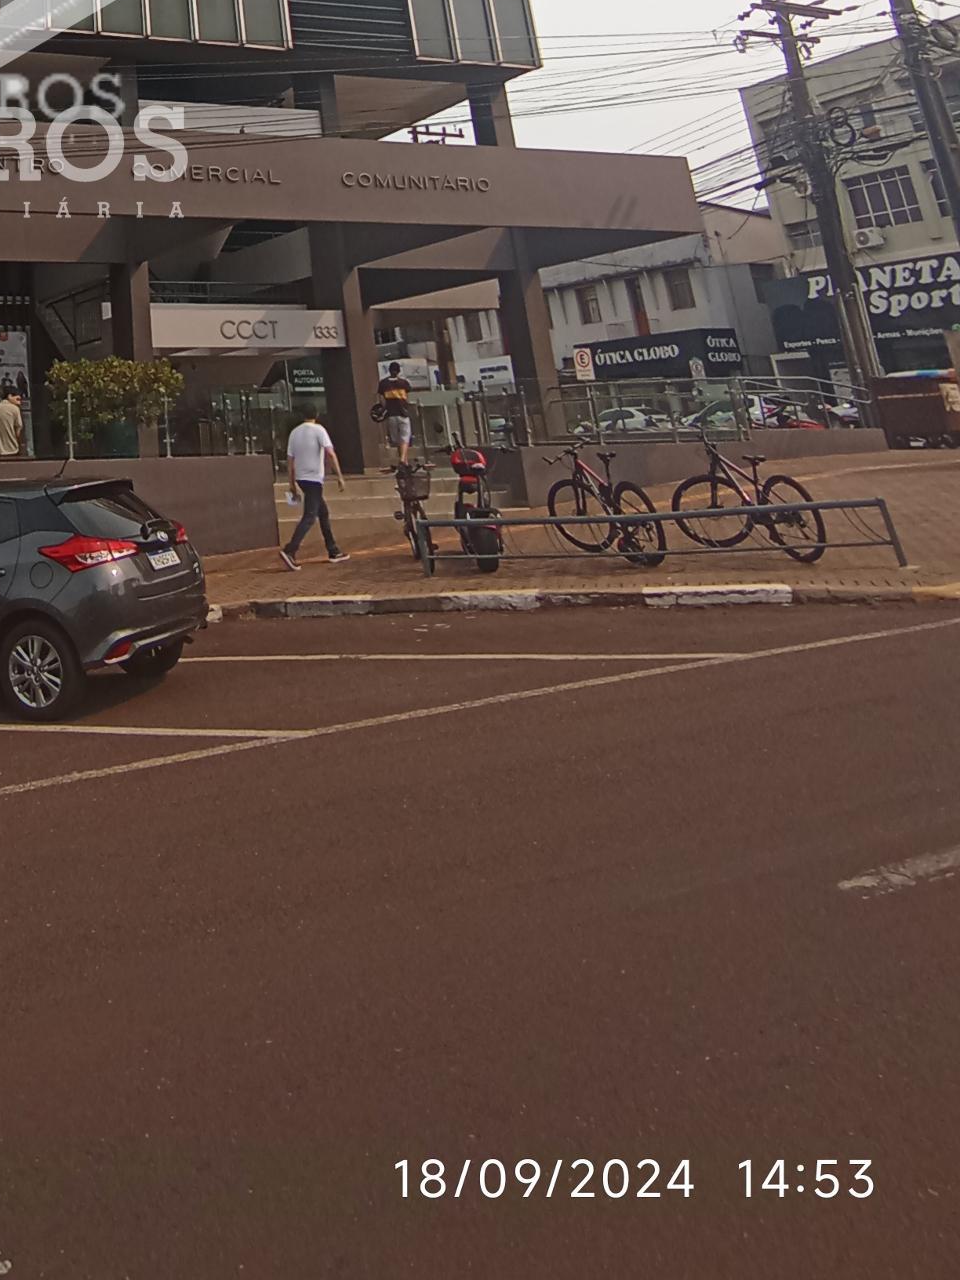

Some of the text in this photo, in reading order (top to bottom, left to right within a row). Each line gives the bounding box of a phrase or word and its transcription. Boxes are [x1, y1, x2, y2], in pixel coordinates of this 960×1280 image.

[132, 160, 282, 184] COMERCIAL
[220, 320, 278, 339] CCCT
[313, 326, 338, 339] 1333
[707, 336, 736, 347] ÓTICA
[595, 344, 679, 366] ÓTICA GLOBO
[708, 352, 740, 362] GLOBO
